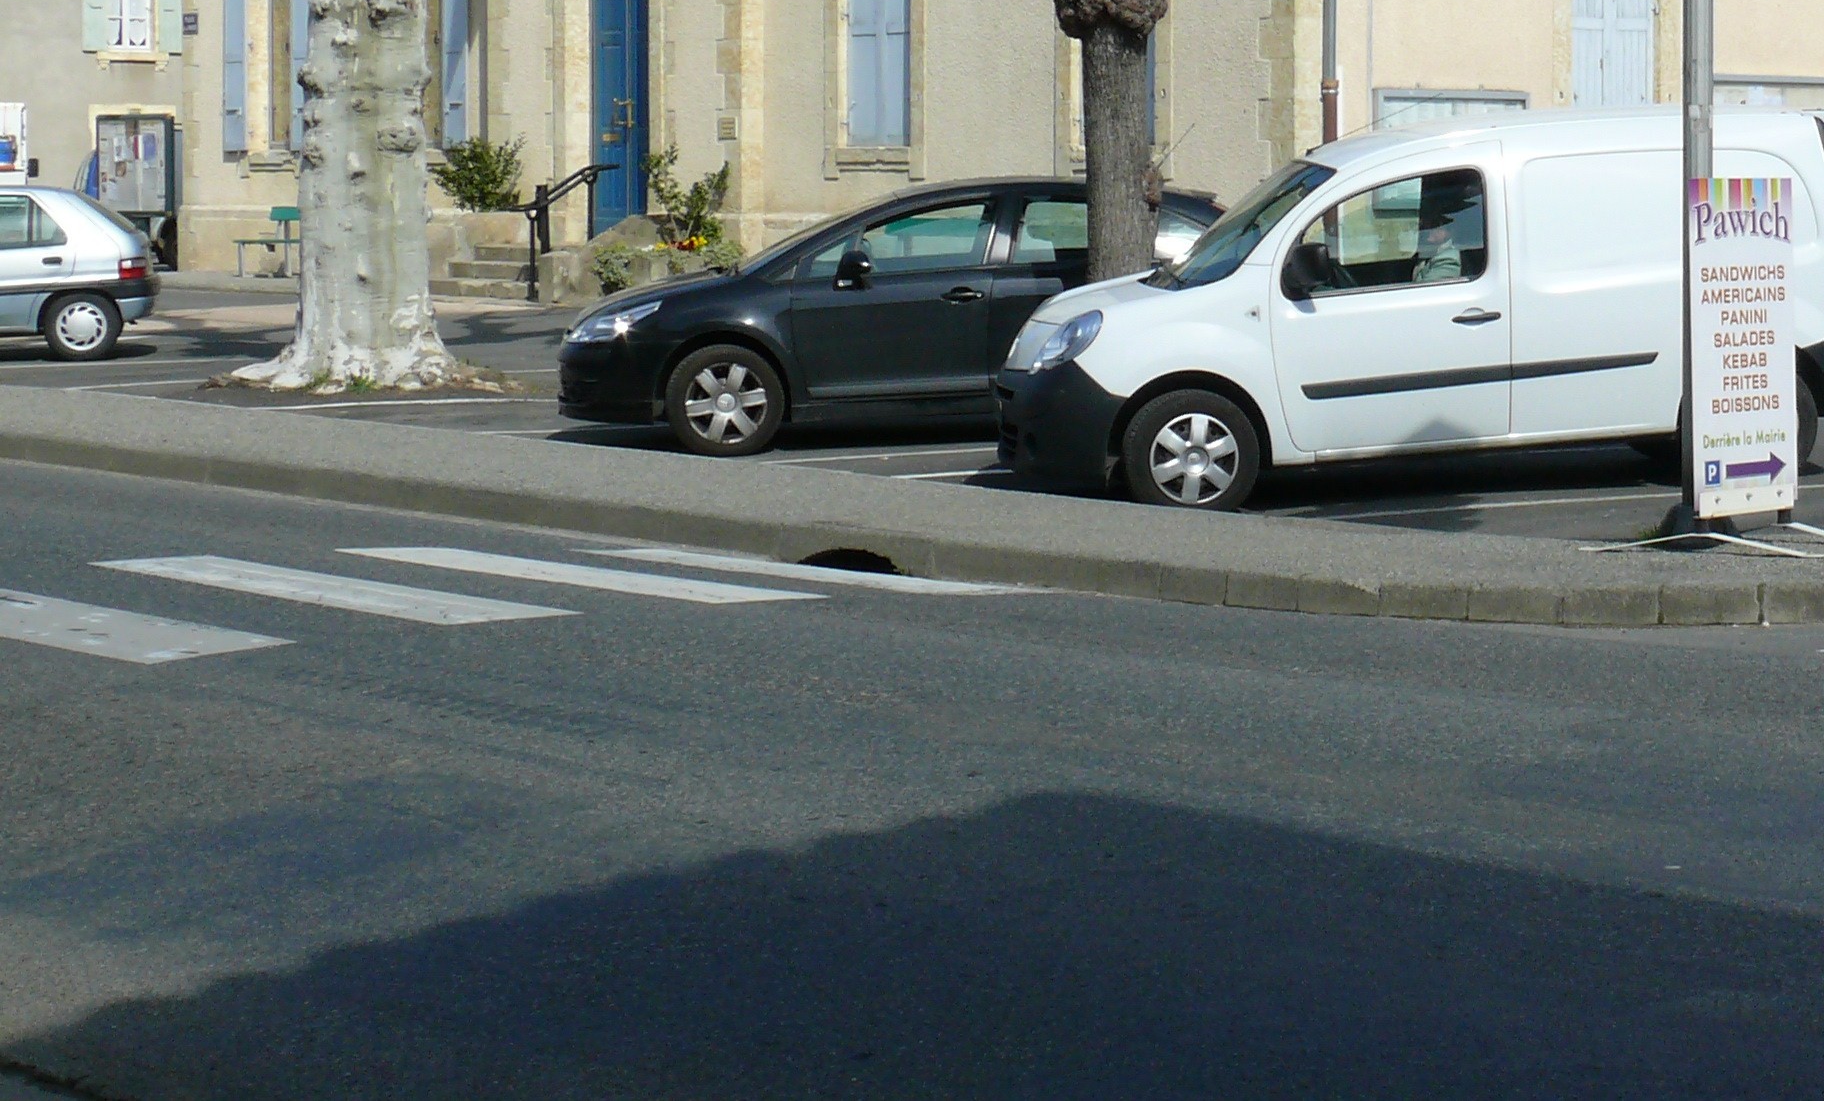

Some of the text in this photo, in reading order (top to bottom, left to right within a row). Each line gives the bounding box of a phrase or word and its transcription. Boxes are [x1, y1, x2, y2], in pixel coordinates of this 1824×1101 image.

[1693, 197, 1791, 245] Pawich
[1700, 264, 1785, 283] SANDWICHS
[1701, 286, 1786, 305] AMERICAINS
[1721, 309, 1767, 325] PANINI
[1714, 330, 1775, 348] SALADES
[1723, 352, 1767, 369] KEBAB
[1723, 374, 1768, 391] FRITES
[1712, 394, 1780, 414] BOISSONS
[1703, 429, 1786, 449] Derrière la Mairie
[1708, 463, 1717, 482] P
